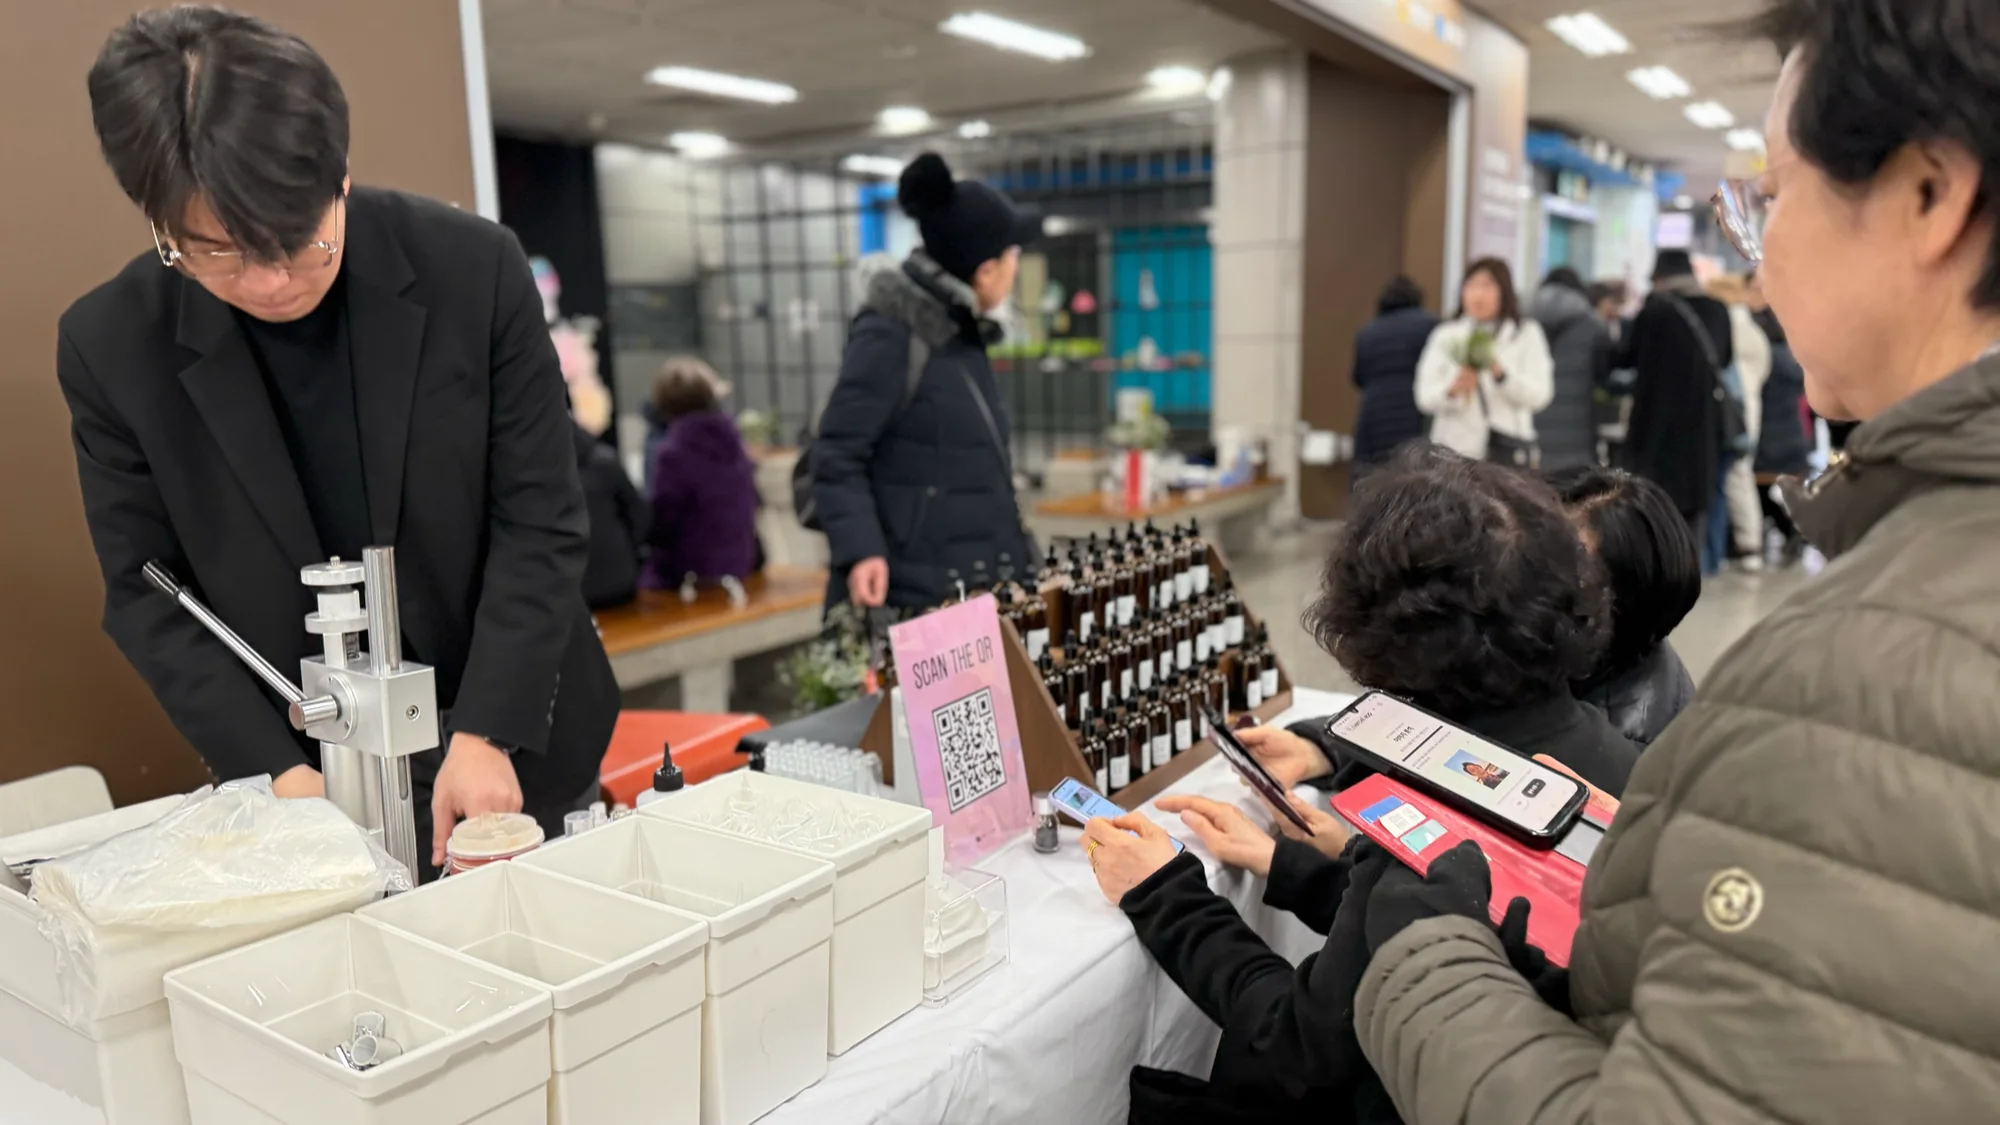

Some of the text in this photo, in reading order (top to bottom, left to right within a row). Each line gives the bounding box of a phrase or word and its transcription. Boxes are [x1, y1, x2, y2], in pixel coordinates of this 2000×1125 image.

[912, 635, 994, 690] SCAN THE QR
